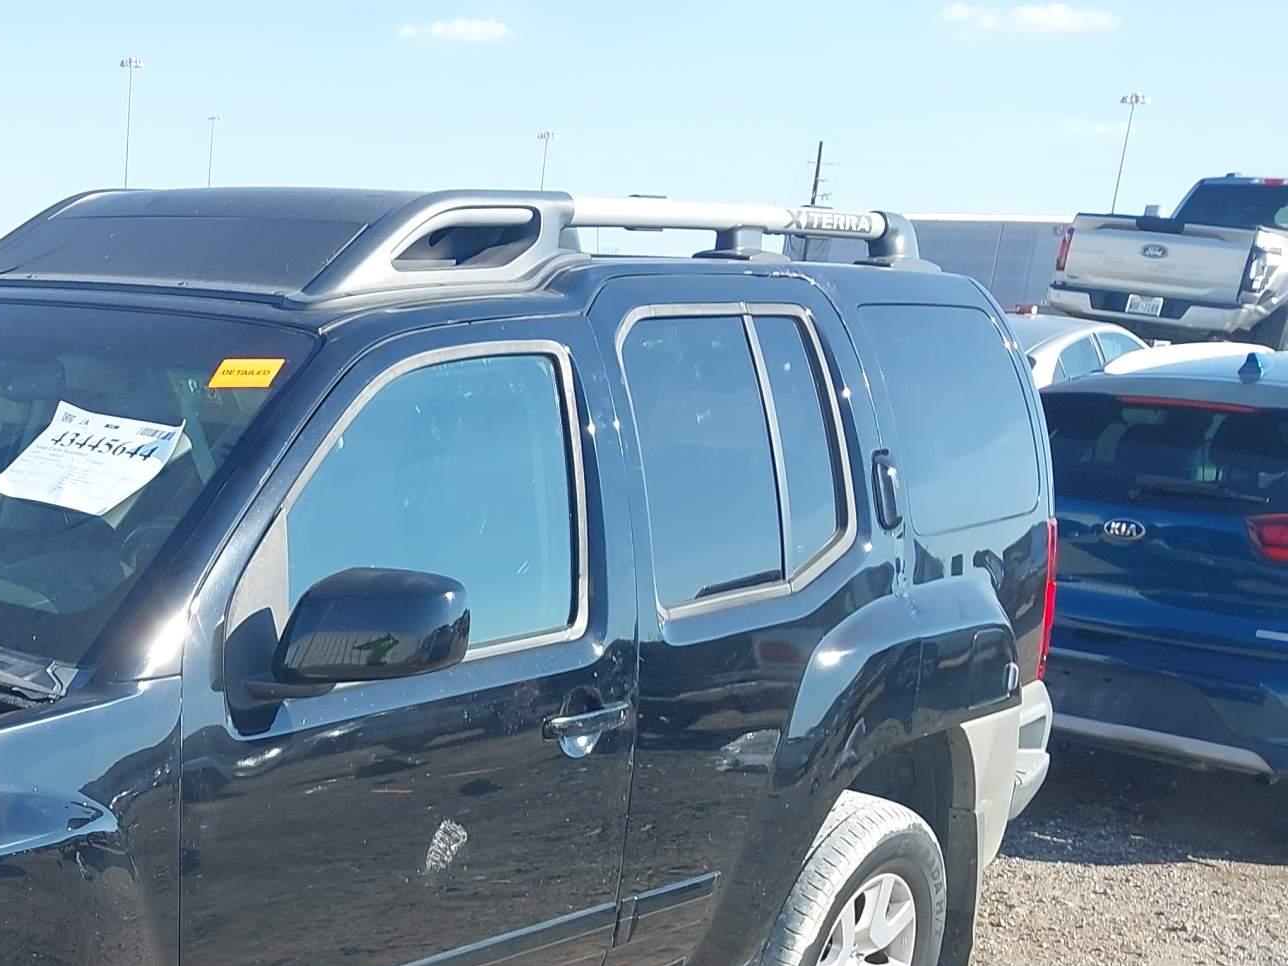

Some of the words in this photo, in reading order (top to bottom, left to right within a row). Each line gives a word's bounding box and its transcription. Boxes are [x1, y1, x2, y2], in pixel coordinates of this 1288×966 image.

[784, 209, 873, 232] XTERRA
[51, 430, 159, 461] 43445644
[1109, 521, 1139, 537] KIA
